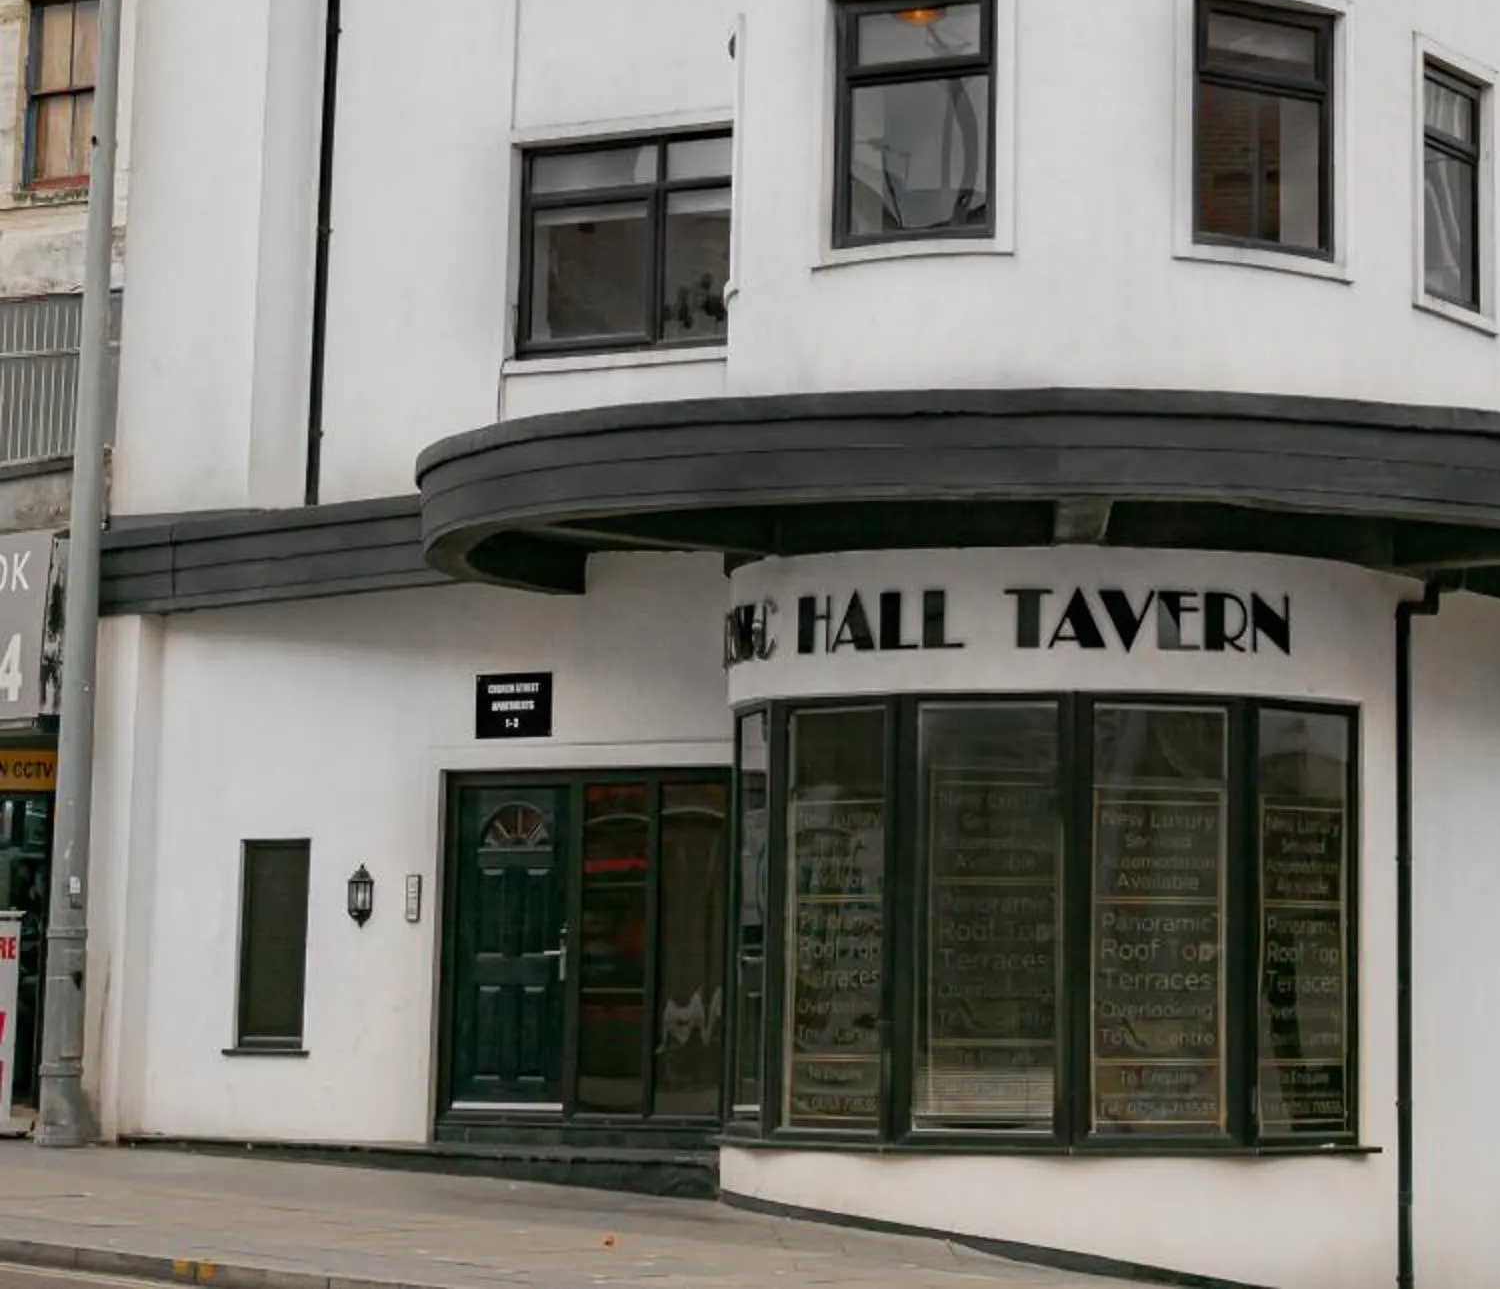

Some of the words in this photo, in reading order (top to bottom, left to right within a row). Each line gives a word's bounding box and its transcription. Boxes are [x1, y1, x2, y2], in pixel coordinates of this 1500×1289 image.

[797, 590, 965, 654] HALL
[1004, 587, 1291, 655] TAVERN
[14, 761, 53, 779] CCTV
[1102, 912, 1214, 933] Panoramic
[1101, 938, 1161, 962] Roof
[1101, 968, 1213, 992] Terraces
[1266, 970, 1341, 993] Terraces
